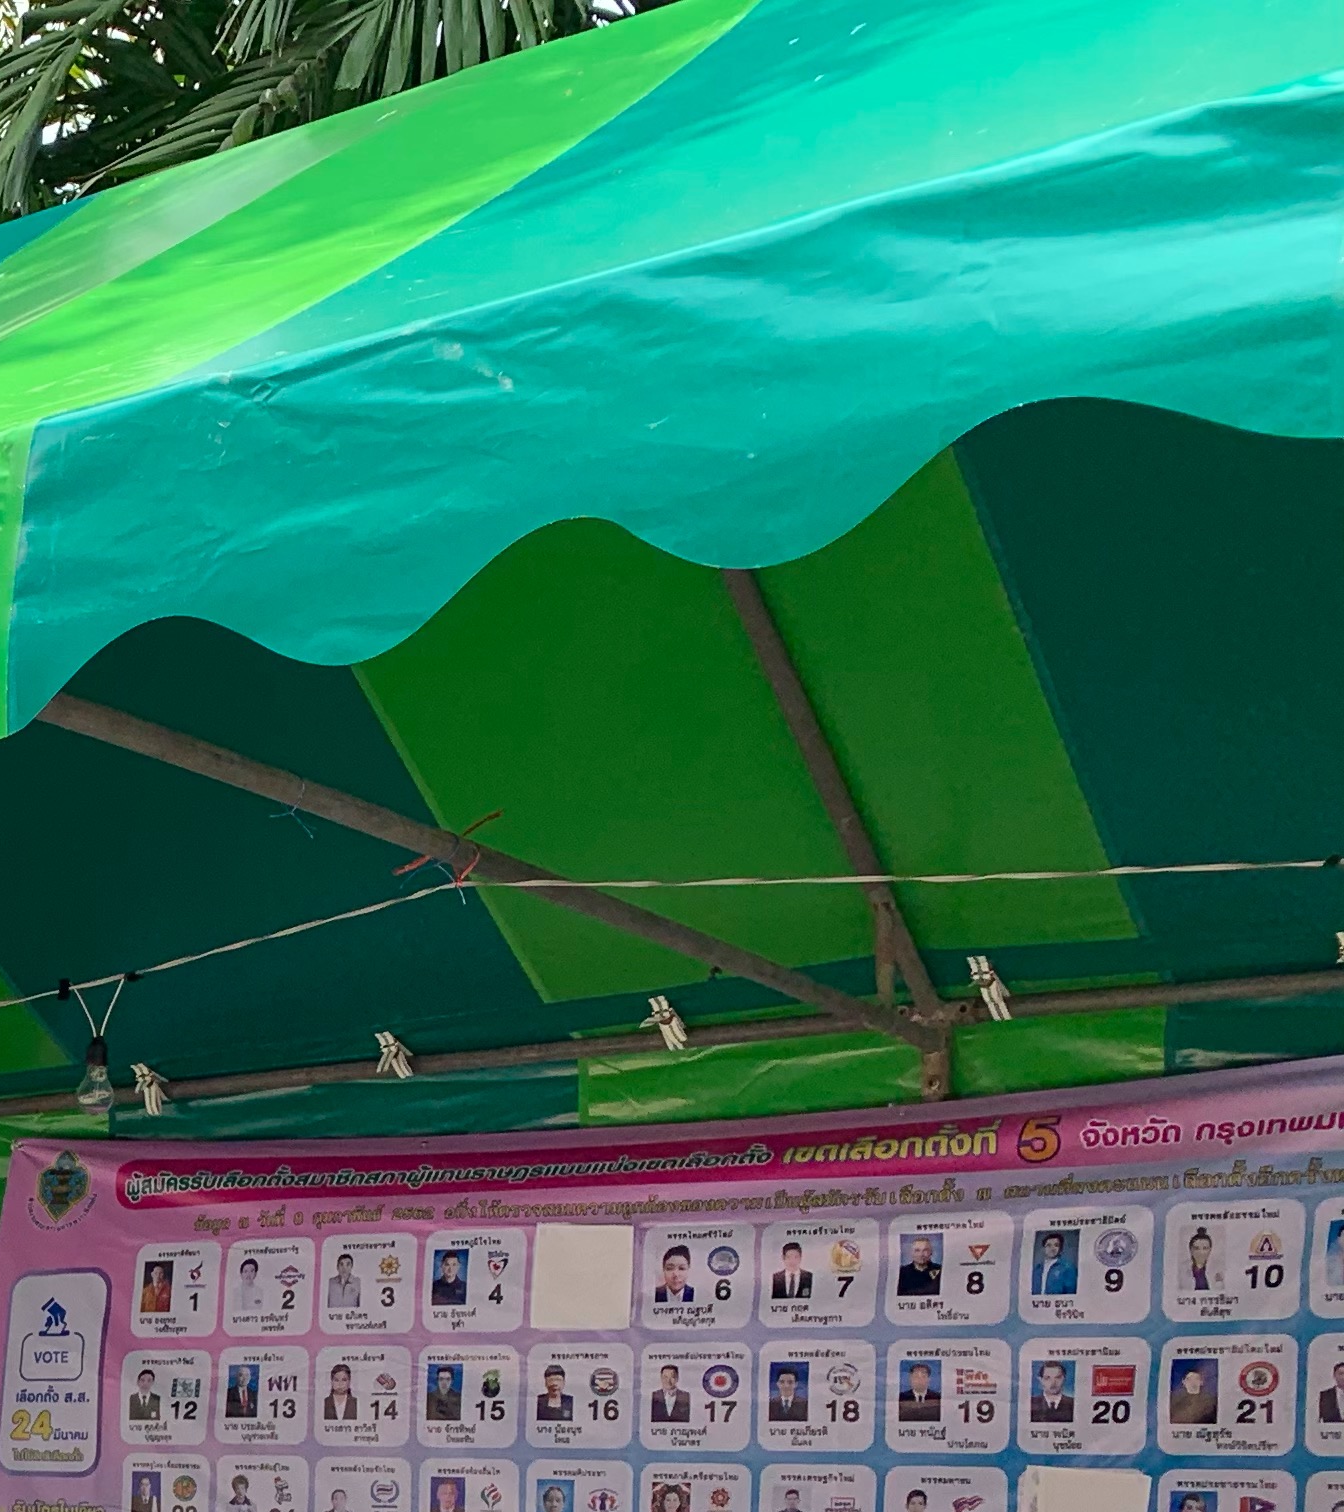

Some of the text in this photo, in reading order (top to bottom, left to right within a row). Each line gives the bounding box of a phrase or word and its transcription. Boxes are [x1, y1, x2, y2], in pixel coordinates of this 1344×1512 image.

[781, 1118, 1002, 1166] เขตเลือกตั้งที่
[1017, 1115, 1062, 1164] 5
[1080, 1114, 1182, 1149] จังหวัด
[1194, 1109, 1344, 1146] กรุงเทพม
[837, 1276, 854, 1298] 7
[966, 1272, 985, 1295] 8
[1105, 1269, 1124, 1292] 9
[1245, 1264, 1284, 1289] 10
[281, 1290, 295, 1310] 2
[381, 1287, 395, 1307] 3
[489, 1284, 503, 1305] 4
[715, 1279, 732, 1301] 6
[189, 1292, 199, 1312] 1
[33, 1350, 70, 1364] VOTE
[15, 1384, 60, 1403] เลือกตั้ง
[171, 1401, 198, 1420] 12
[269, 1399, 296, 1418] 13
[370, 1399, 398, 1420] 14
[475, 1400, 506, 1421] 15
[588, 1400, 619, 1421] 16
[704, 1400, 737, 1423] 17
[826, 1400, 860, 1422] 18
[958, 1400, 995, 1424] 19
[1091, 1401, 1130, 1424] 20
[1236, 1400, 1274, 1424] 21
[10, 1408, 89, 1442] 24 มีนาคม
